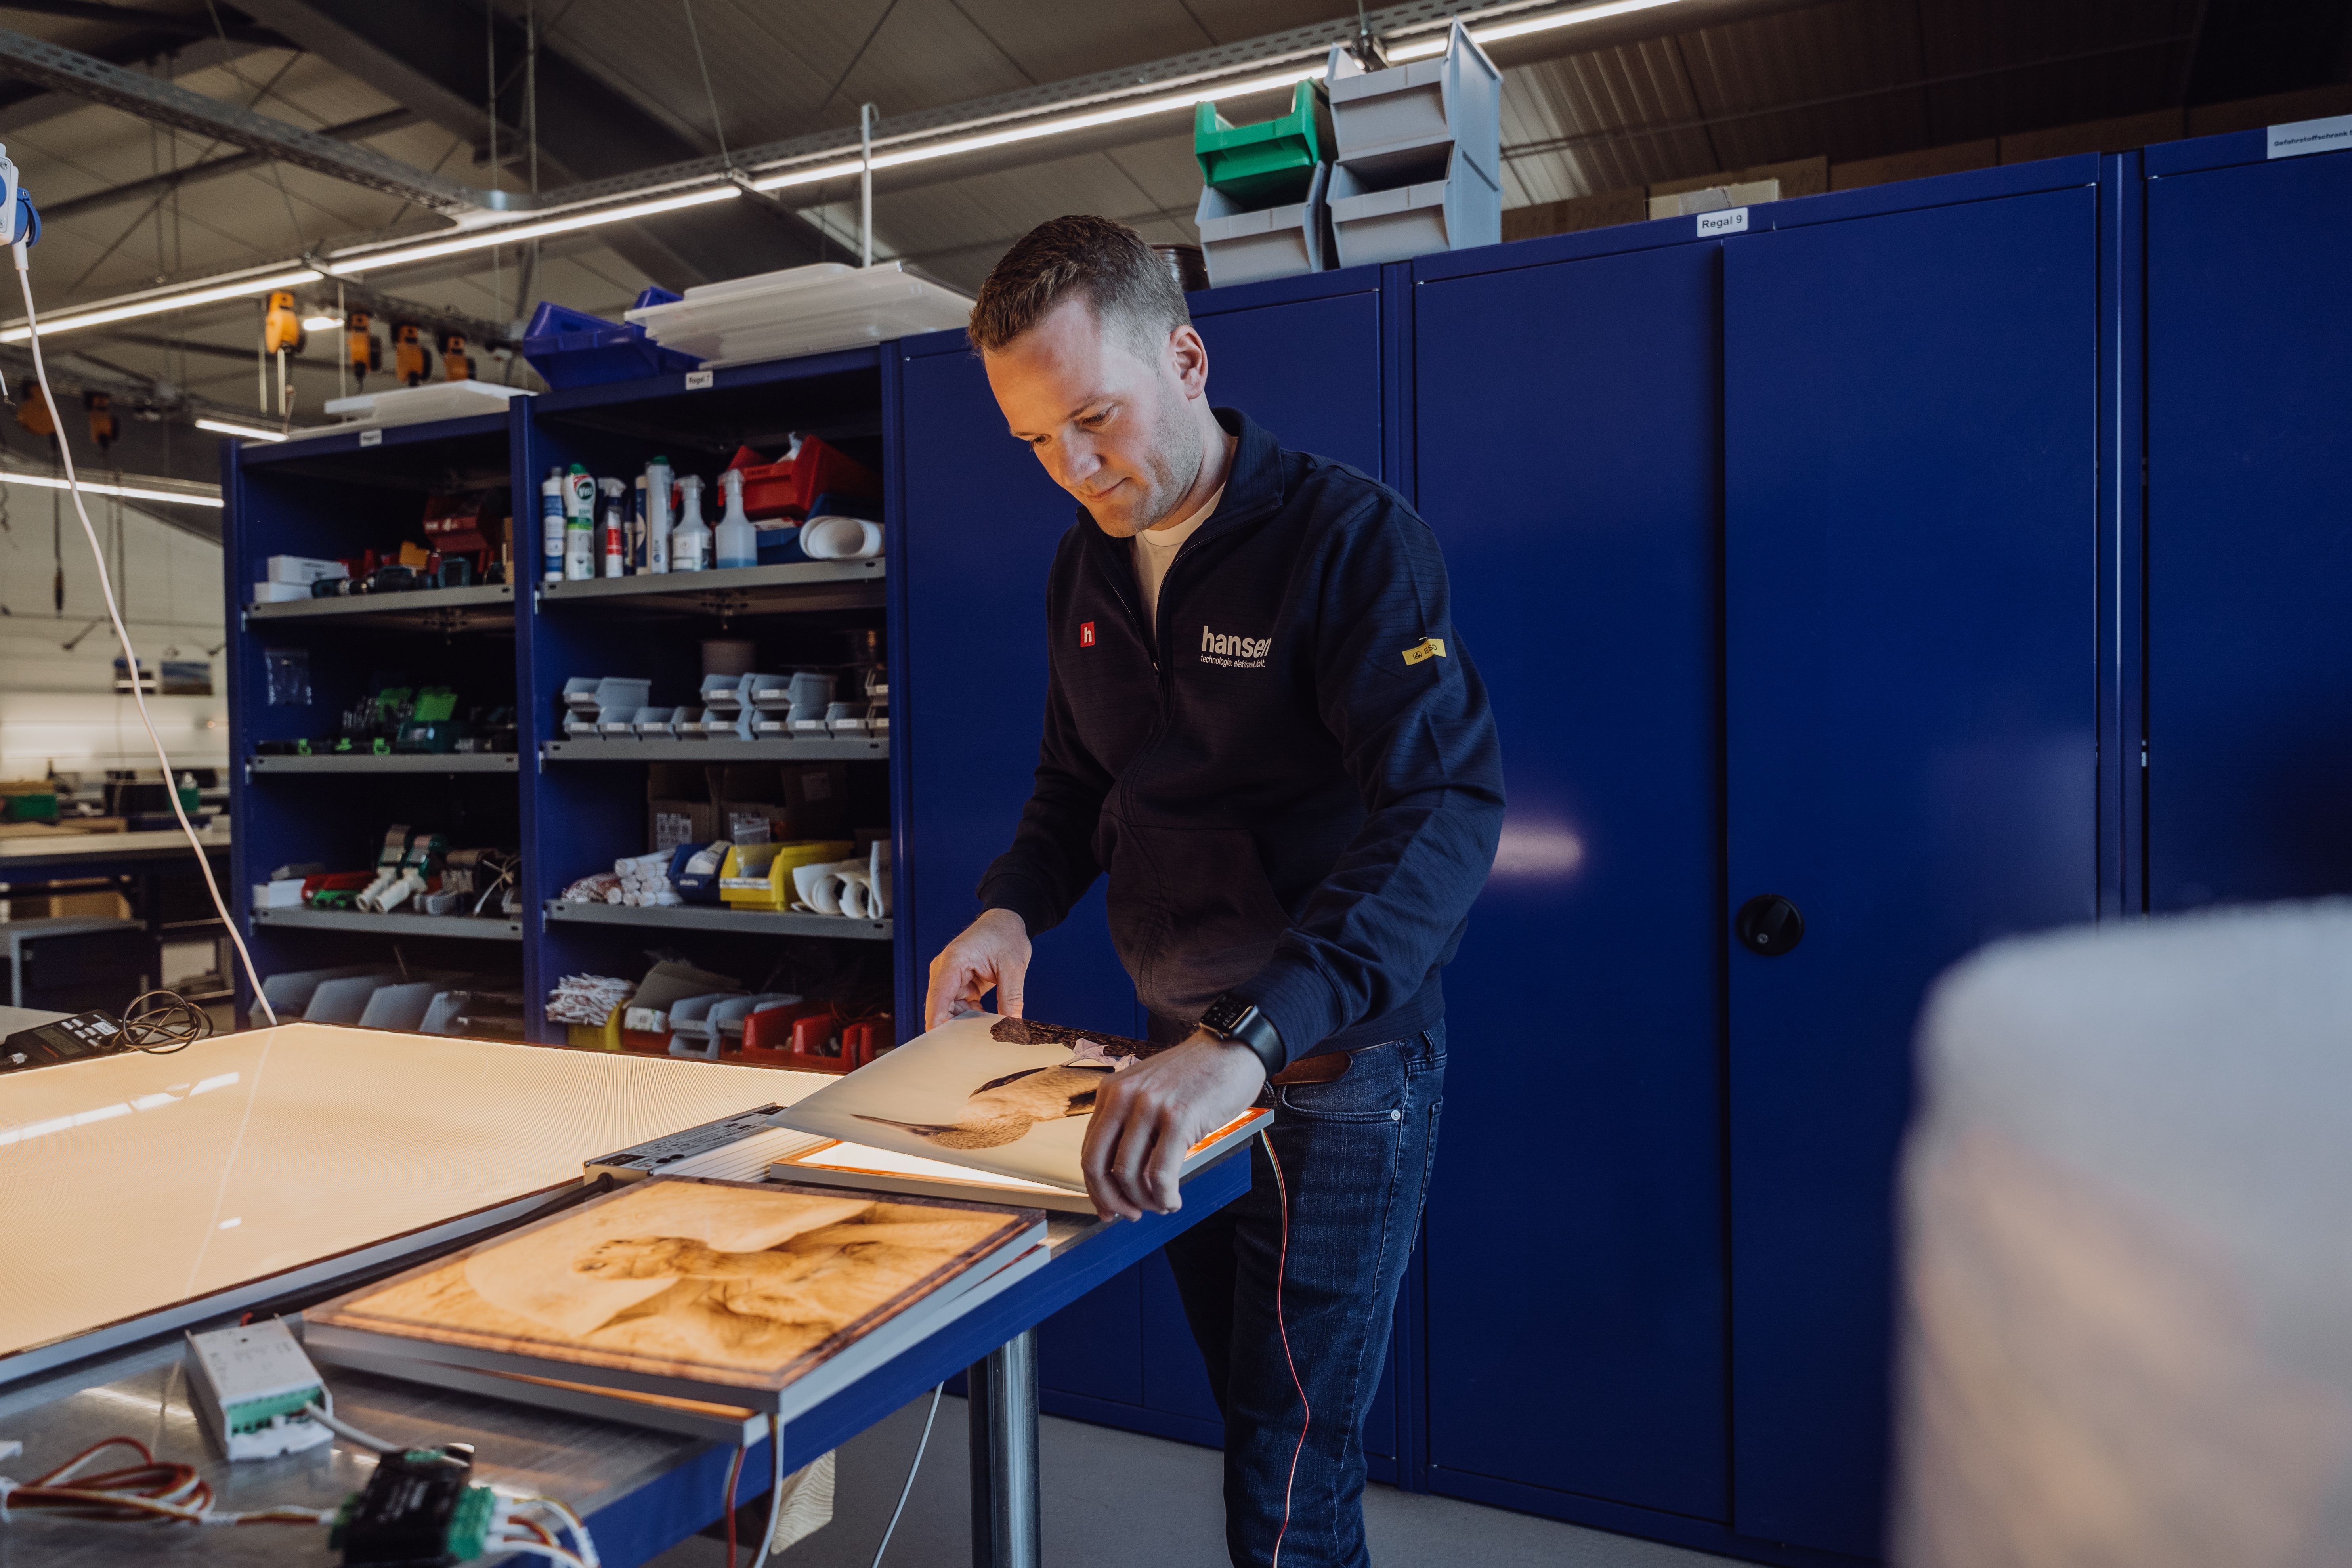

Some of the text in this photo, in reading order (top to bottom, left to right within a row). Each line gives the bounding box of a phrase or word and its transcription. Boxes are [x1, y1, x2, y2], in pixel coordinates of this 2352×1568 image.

[2274, 131, 2348, 146] Gefahrstoffschrank
[1702, 216, 1732, 229] Regal
[1084, 627, 1092, 643] h
[1202, 625, 1271, 658] hansen
[1424, 644, 1437, 654] ESD
[1201, 654, 1232, 668] technologie.
